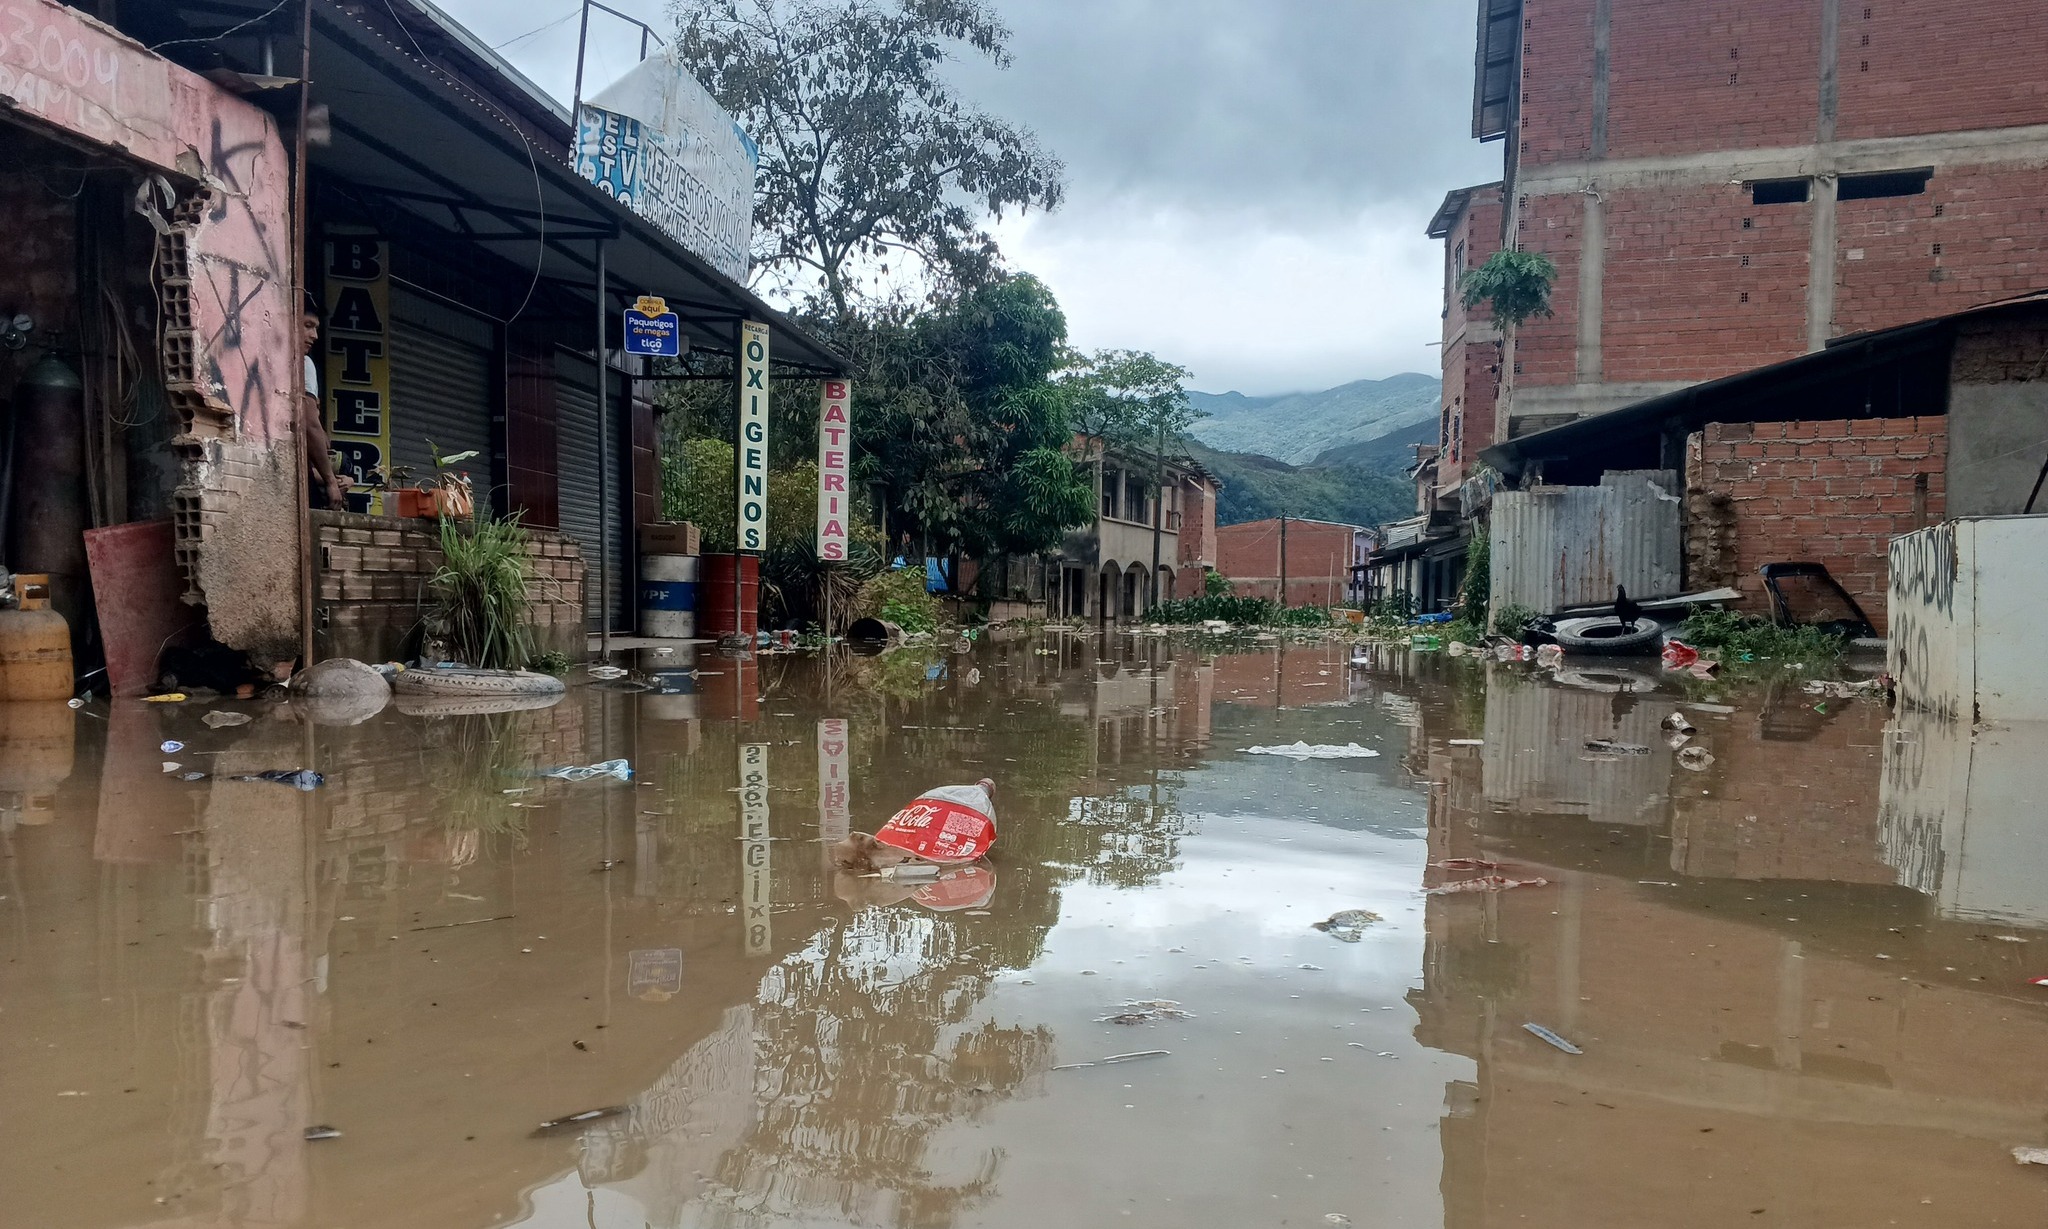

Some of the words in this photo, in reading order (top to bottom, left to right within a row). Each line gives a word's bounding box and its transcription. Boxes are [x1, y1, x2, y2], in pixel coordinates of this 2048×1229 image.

[0, 6, 119, 118] 3004
[641, 187, 690, 249] LUBRICANTES
[644, 139, 713, 231] REPUESTOS
[713, 196, 744, 257] VOLVO
[628, 317, 674, 329] Paquetigos
[633, 326, 643, 334] de
[644, 328, 670, 337] megas
[752, 333, 760, 341] DE
[744, 341, 764, 549] OXIGENOS
[822, 381, 847, 560] BATERIAS
[642, 590, 670, 600] YPF
